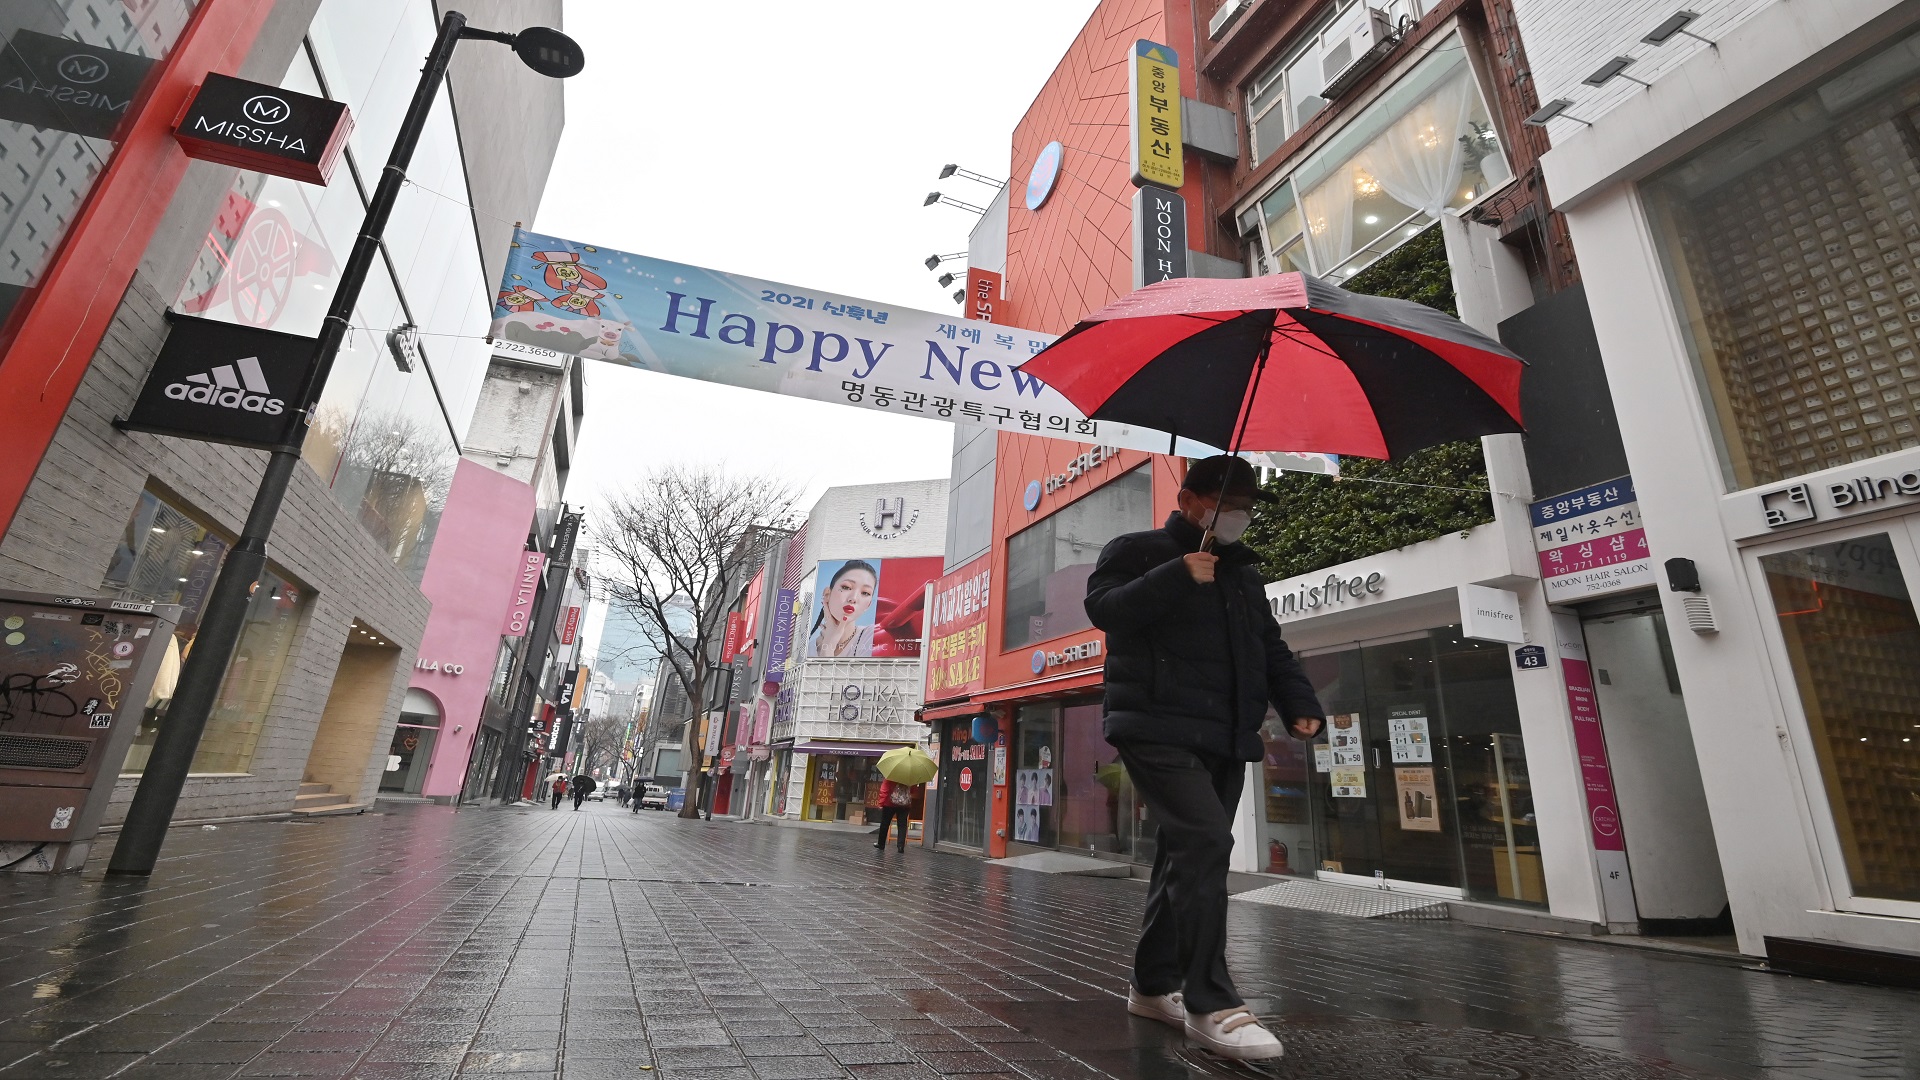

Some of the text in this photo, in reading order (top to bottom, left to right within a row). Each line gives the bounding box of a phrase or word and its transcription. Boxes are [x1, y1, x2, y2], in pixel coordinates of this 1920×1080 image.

[194, 115, 306, 154] MISSHA
[1155, 197, 1172, 254] MOON
[761, 289, 813, 311] 2021
[976, 278, 994, 323] the SA
[659, 290, 1047, 399] Happy New
[935, 323, 1048, 355] 새해 복 많
[164, 382, 286, 416] adidas
[841, 379, 1098, 438] 명동관광특구협의회
[1046, 472, 1066, 495] the
[1541, 486, 1619, 519] 중앙부동산
[1551, 563, 1649, 589] MOON HAIR SALON
[1553, 552, 1627, 575] Tel 771 1119
[510, 554, 540, 632] BANILA CO
[1269, 571, 1384, 616] nnisfree
[1586, 578, 1621, 591] 752-0368
[775, 595, 791, 633] HOLIKA
[1477, 607, 1514, 621] innisfree
[941, 630, 967, 659] 전품목
[967, 621, 987, 648] 추가
[443, 662, 464, 675] CO
[948, 655, 980, 688] SALE
[1047, 651, 1063, 667] the
[1524, 656, 1538, 667] 43
[560, 683, 574, 705] FILA
[829, 684, 903, 702] HOLIKA
[91, 720, 110, 728] RAT
[93, 714, 111, 722] LAB
[827, 704, 901, 722] HOLIKA
[549, 722, 560, 750] swatch
[1609, 871, 1620, 880] 4F
